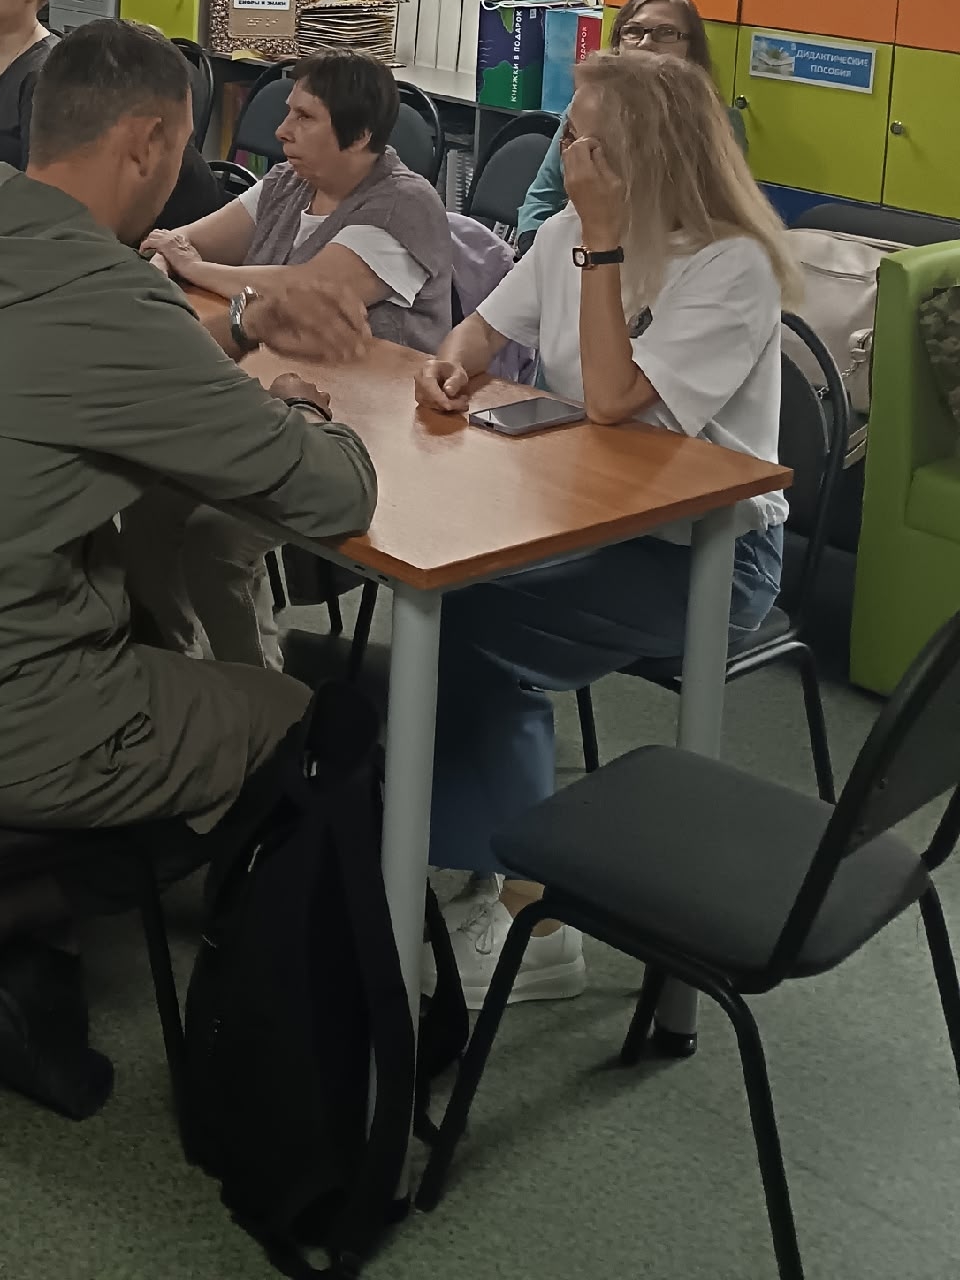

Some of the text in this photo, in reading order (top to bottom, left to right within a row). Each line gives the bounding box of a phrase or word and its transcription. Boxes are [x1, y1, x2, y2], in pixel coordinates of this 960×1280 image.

[514, 10, 523, 52] ПОДАРОК
[796, 49, 868, 67] ДИДАКТИЧЕСКИЕ
[810, 64, 851, 77] ПОСОБИЯ
[511, 63, 519, 102] КНИЖКИ
